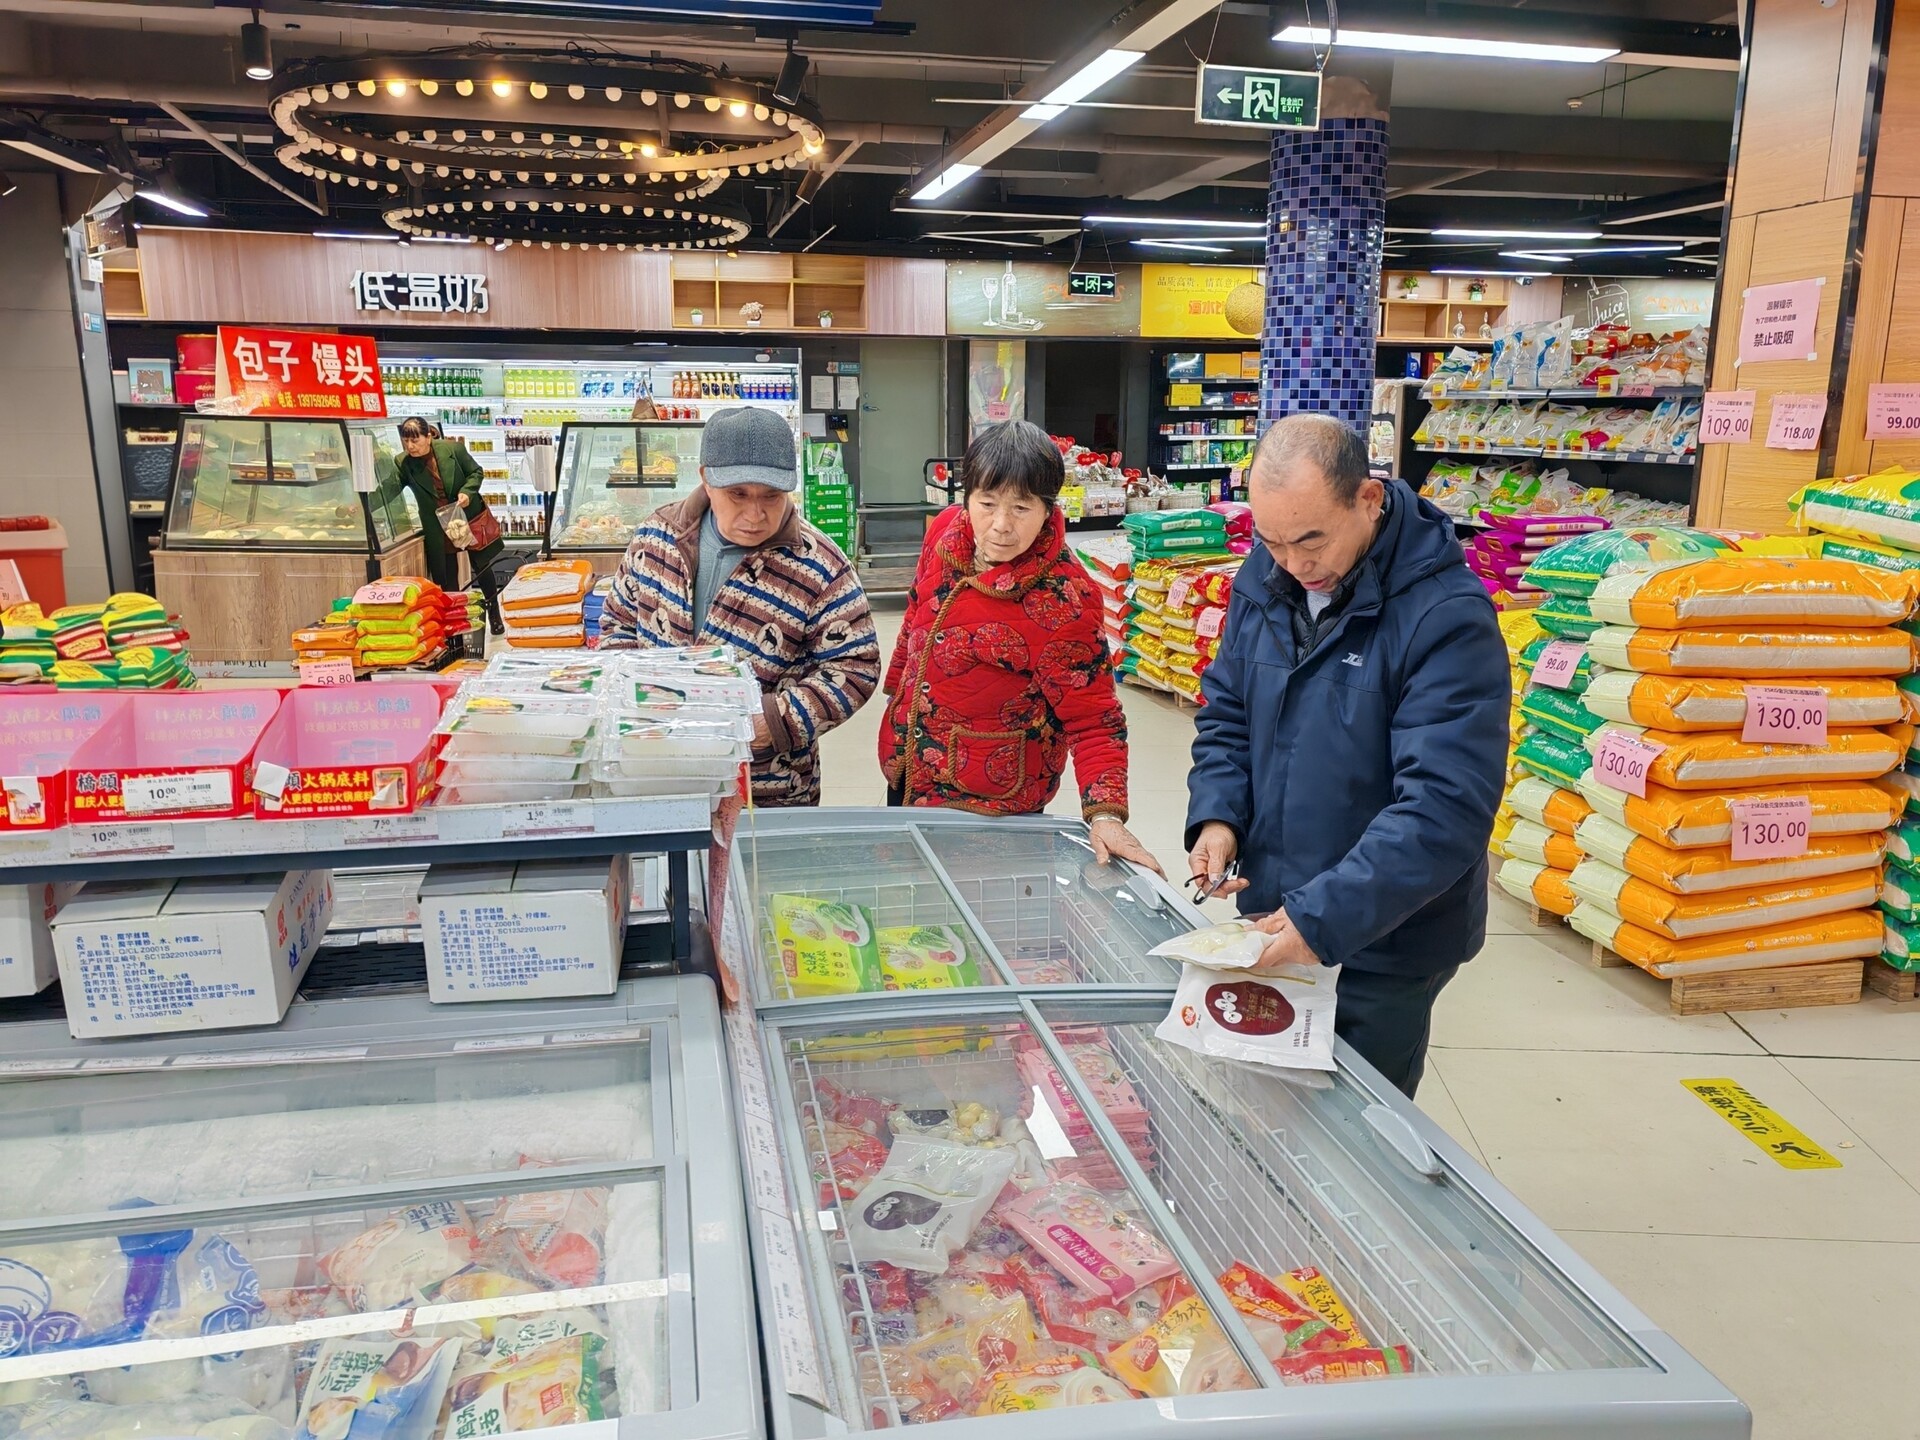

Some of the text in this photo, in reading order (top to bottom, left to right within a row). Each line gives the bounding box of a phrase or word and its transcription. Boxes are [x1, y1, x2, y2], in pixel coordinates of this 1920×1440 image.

[1280, 97, 1304, 106] 安全出口
[1282, 106, 1301, 114] EXIT
[350, 268, 489, 314] 低温奶
[1767, 299, 1792, 310] 温馨提示
[1595, 300, 1625, 325] Juice
[1754, 330, 1794, 347] 禁止吸烟
[233, 336, 375, 387] 包子 馒头
[1707, 418, 1748, 436] 109.00
[1887, 416, 1920, 428] 99.00
[1784, 426, 1815, 440] 118.00
[368, 591, 402, 601] 36.80
[1545, 658, 1569, 672] 99.00
[1758, 706, 1822, 730] 130.00
[1600, 750, 1643, 778] 130.00
[76, 771, 118, 794] 橋頭
[303, 770, 370, 789] 火锅底料
[148, 786, 176, 800] 10.00
[282, 790, 374, 804] 人更爱吃的火锅底料
[526, 810, 544, 821] 1.50
[373, 819, 390, 830] 7.50
[92, 830, 118, 842] 10.00
[1742, 822, 1806, 845] 130.00
[1693, 1086, 1770, 1135] 小心地滑
[328, 1350, 384, 1374] 老母鸡汤
